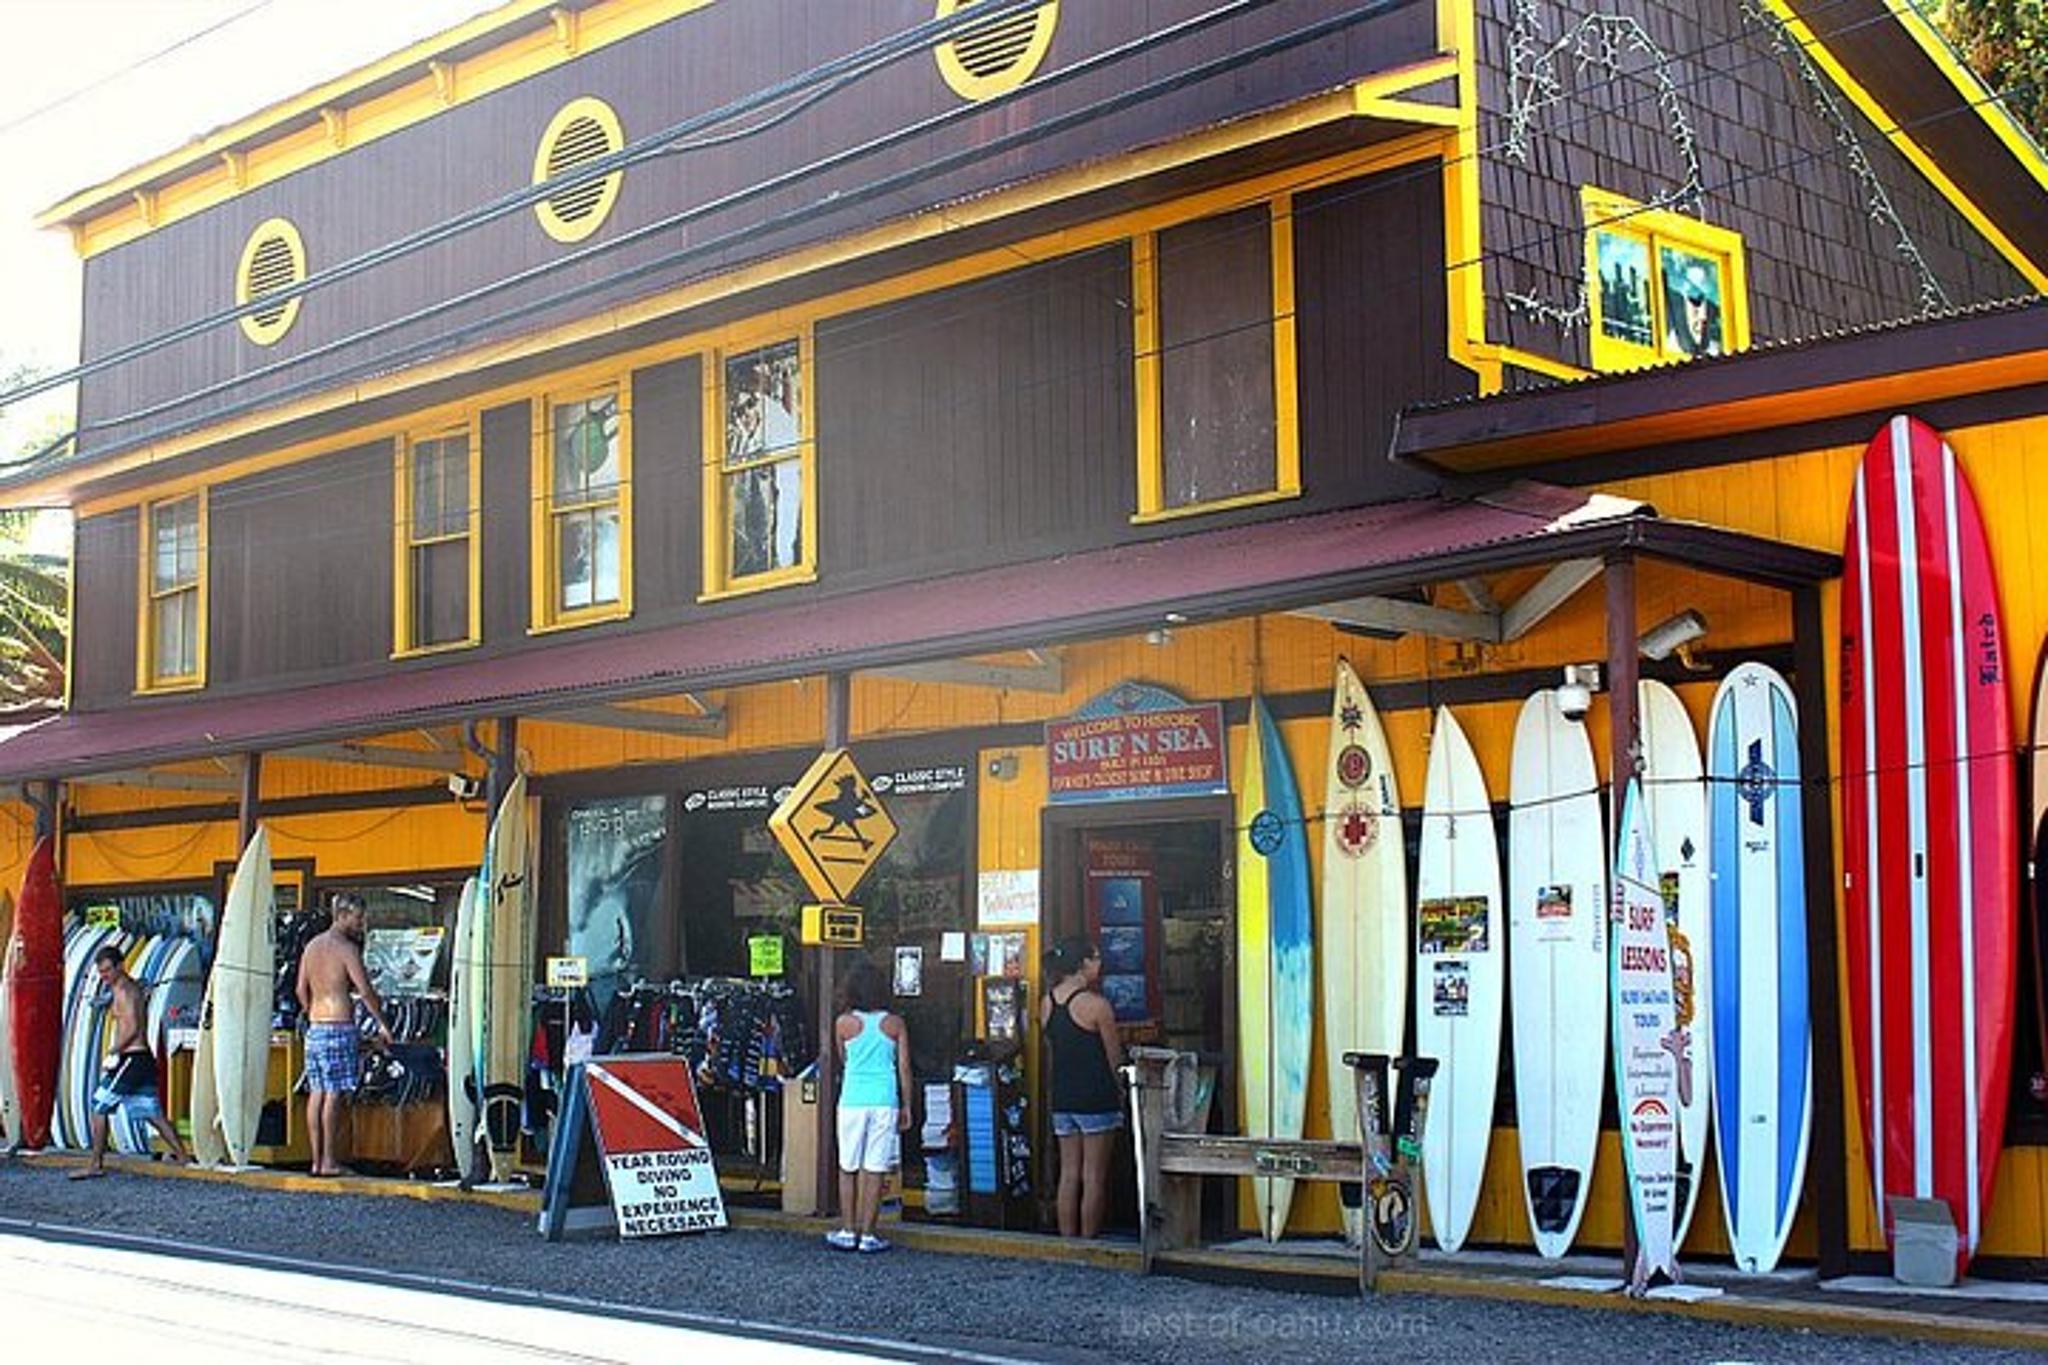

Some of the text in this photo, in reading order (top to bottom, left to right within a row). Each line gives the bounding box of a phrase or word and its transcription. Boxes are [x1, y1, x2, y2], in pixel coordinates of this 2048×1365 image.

[1062, 712, 1202, 740] WELCOME TO HISTORIC
[1054, 727, 1213, 763] SURF N SEA
[1629, 904, 1656, 931] SURF
[1621, 946, 1668, 973] LESSONS
[610, 1150, 710, 1171] YEAR ROUND
[636, 1168, 693, 1185] DIVING
[653, 1185, 678, 1199] NO
[621, 1197, 721, 1218] EXPERIENCE
[624, 1214, 719, 1234] NECESSARY
